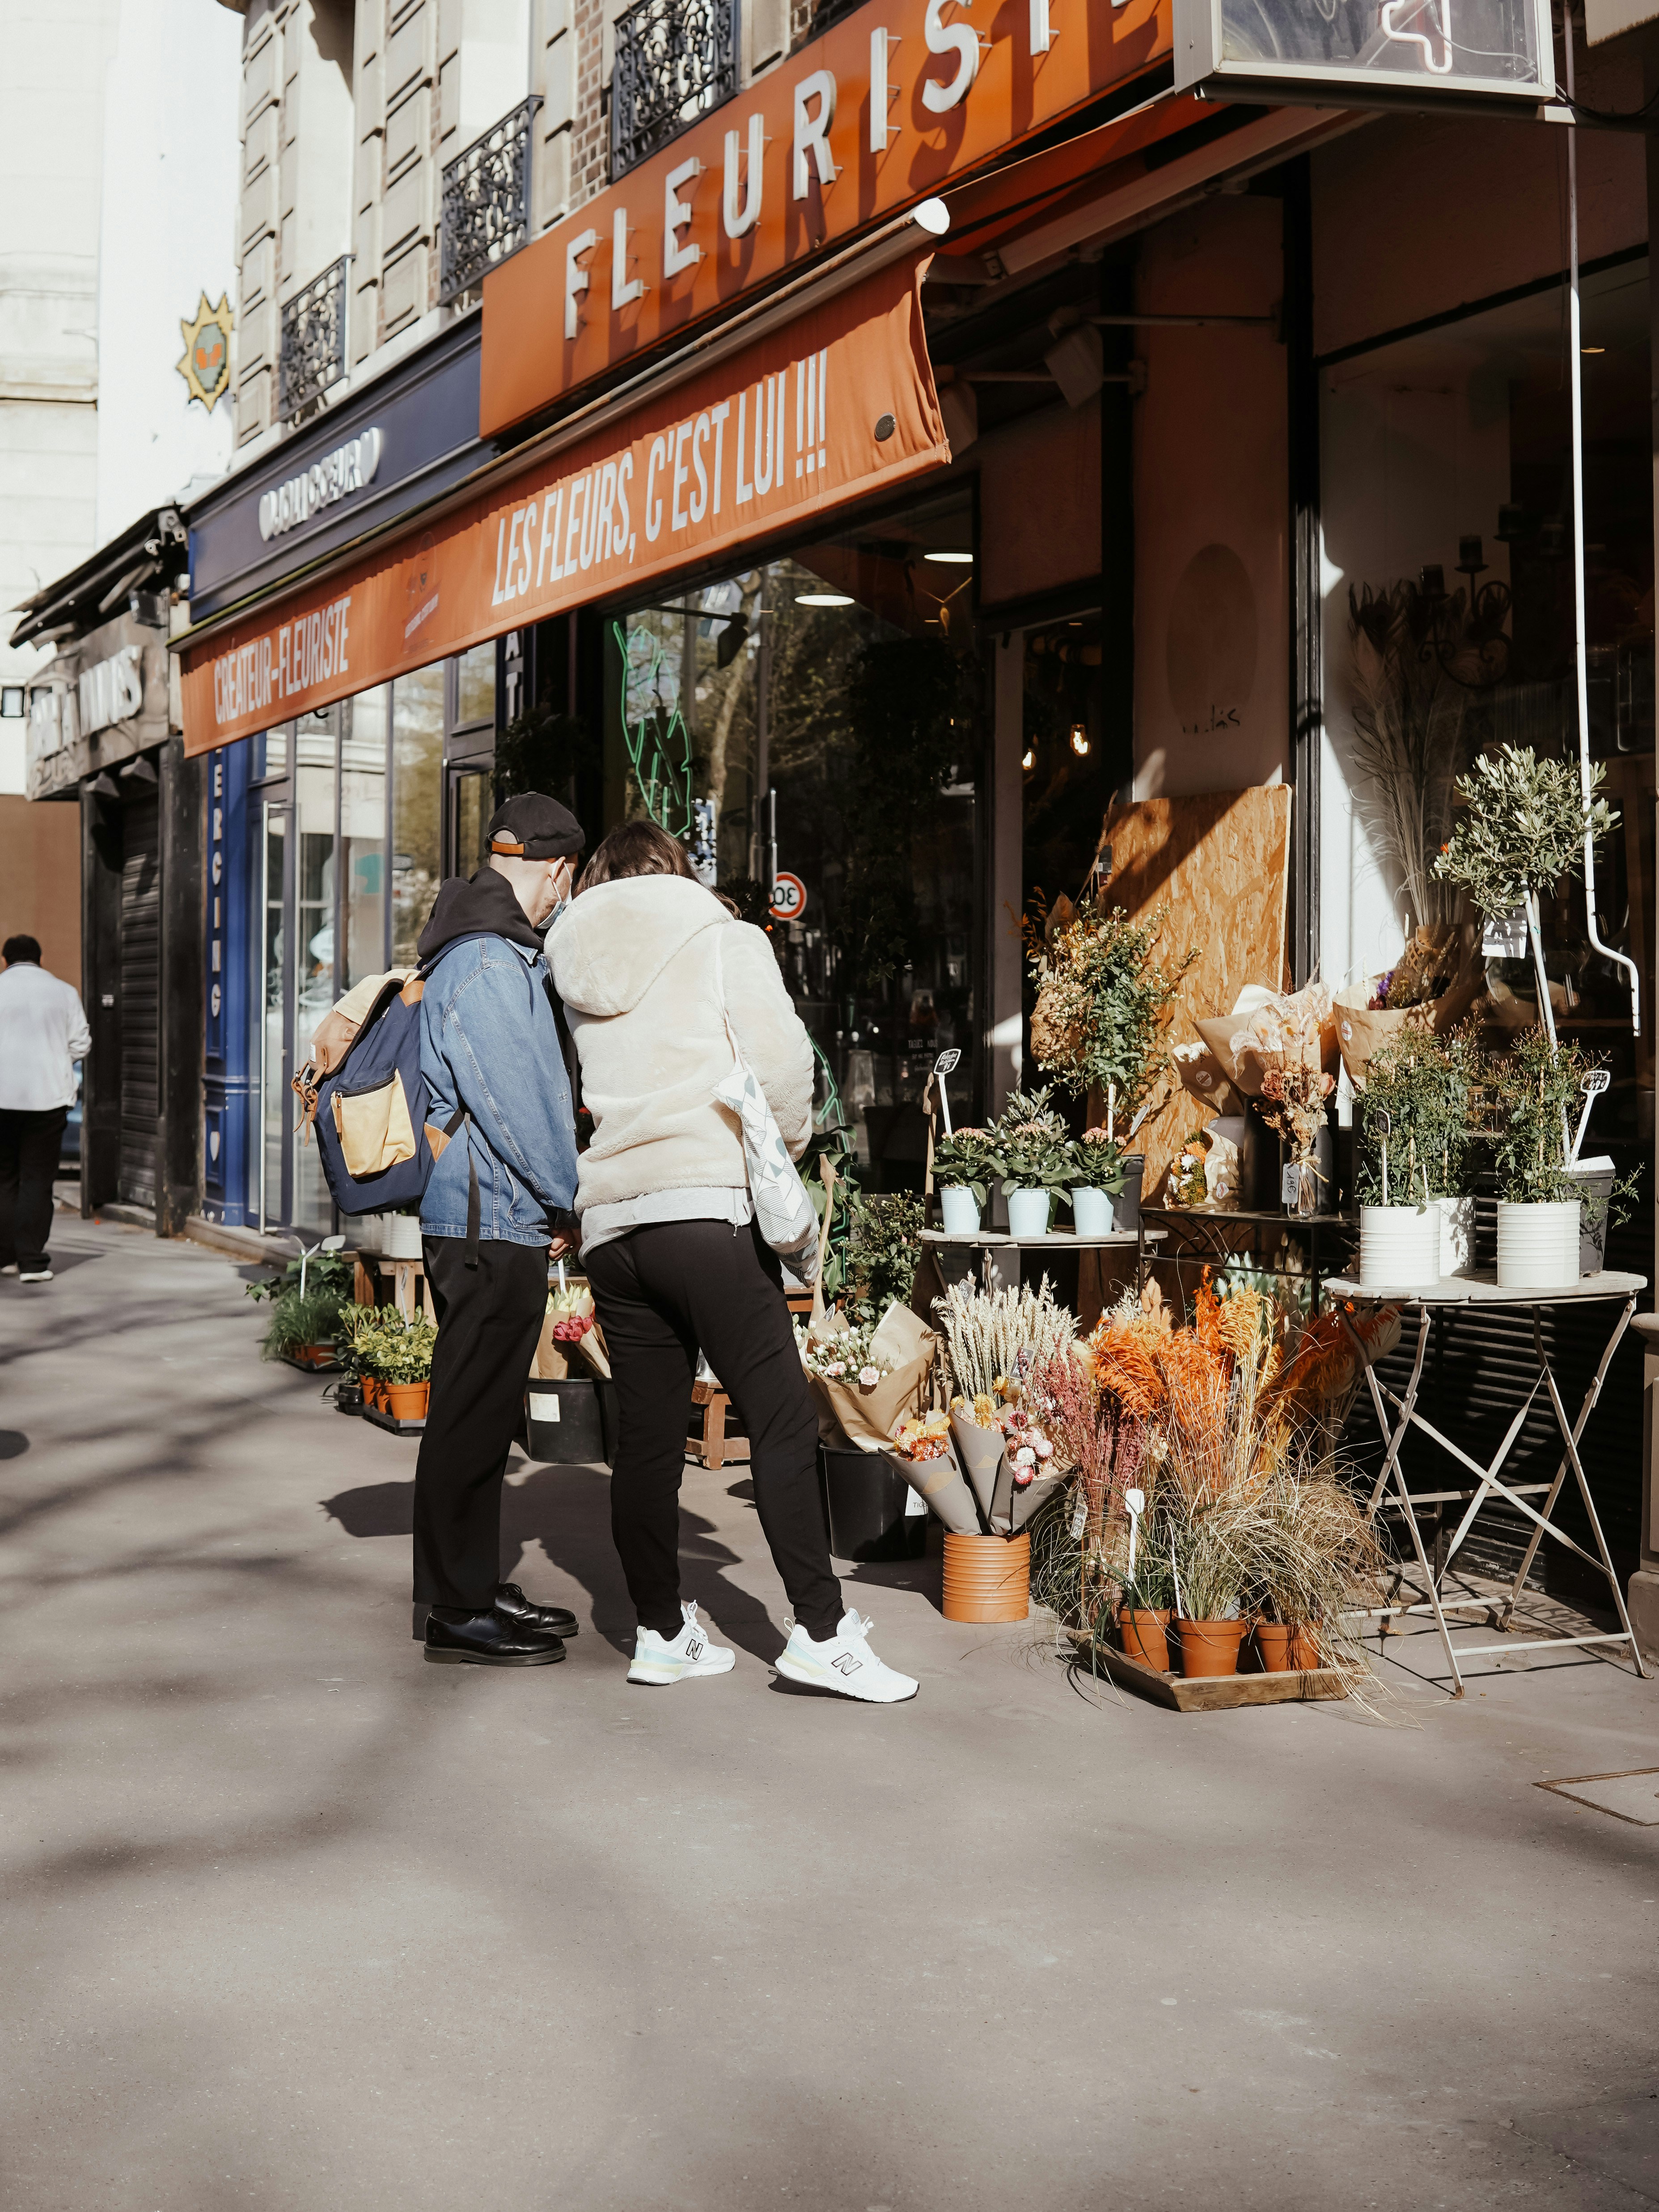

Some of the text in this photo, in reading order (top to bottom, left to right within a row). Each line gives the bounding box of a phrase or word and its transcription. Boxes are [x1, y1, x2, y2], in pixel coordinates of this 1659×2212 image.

[564, 0, 1130, 339] FLEURIS
[492, 347, 827, 606] LES FLEURS, C'EST LUI !!!
[686, 1638, 703, 1661] N
[831, 1652, 863, 1676] N
